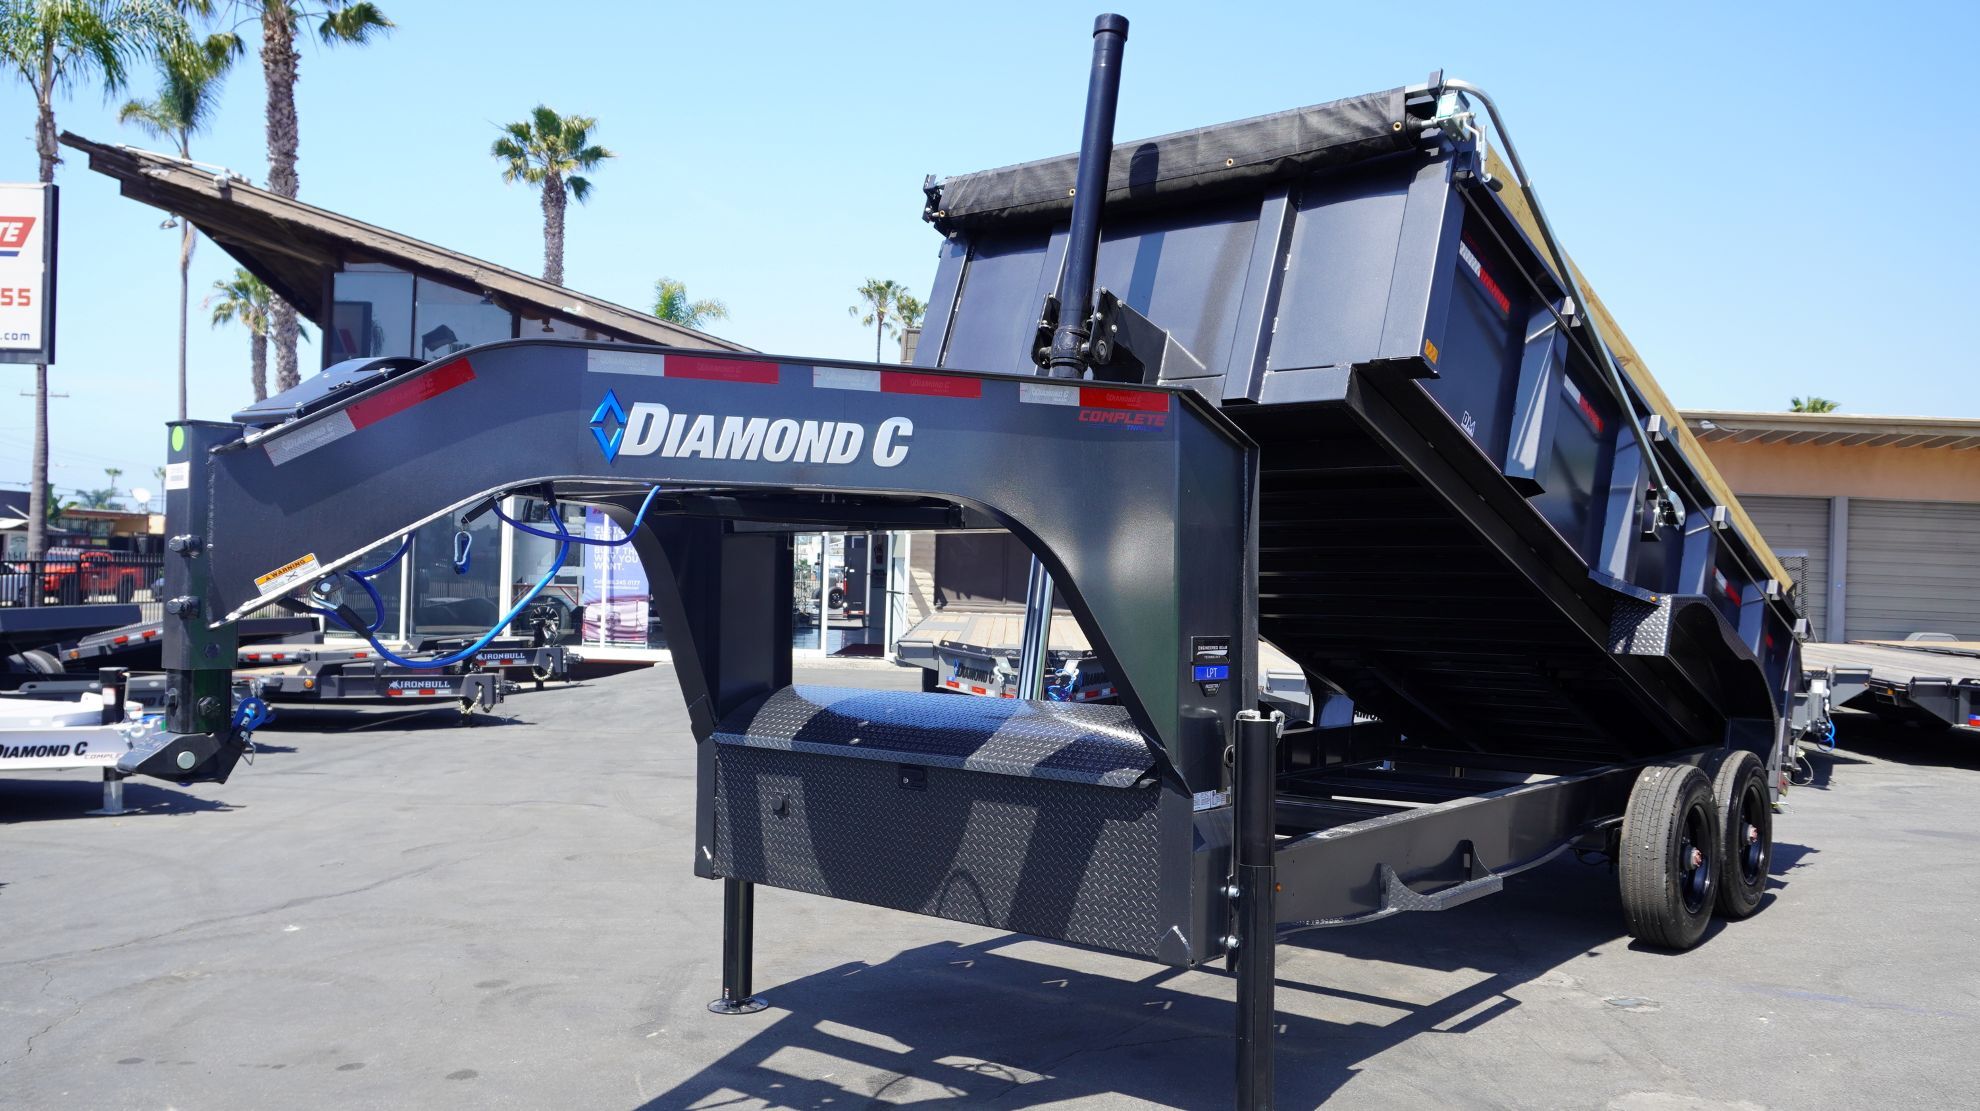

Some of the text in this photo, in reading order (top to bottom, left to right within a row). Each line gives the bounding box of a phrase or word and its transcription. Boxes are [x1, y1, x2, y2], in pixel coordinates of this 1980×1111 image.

[1078, 409, 1168, 426] COMPLETE
[618, 402, 914, 468] DIAMOND C
[619, 555, 639, 563] YOU
[272, 559, 306, 578] WARNING
[1206, 667, 1218, 678] LPT
[0, 741, 88, 759] IAMOND C
